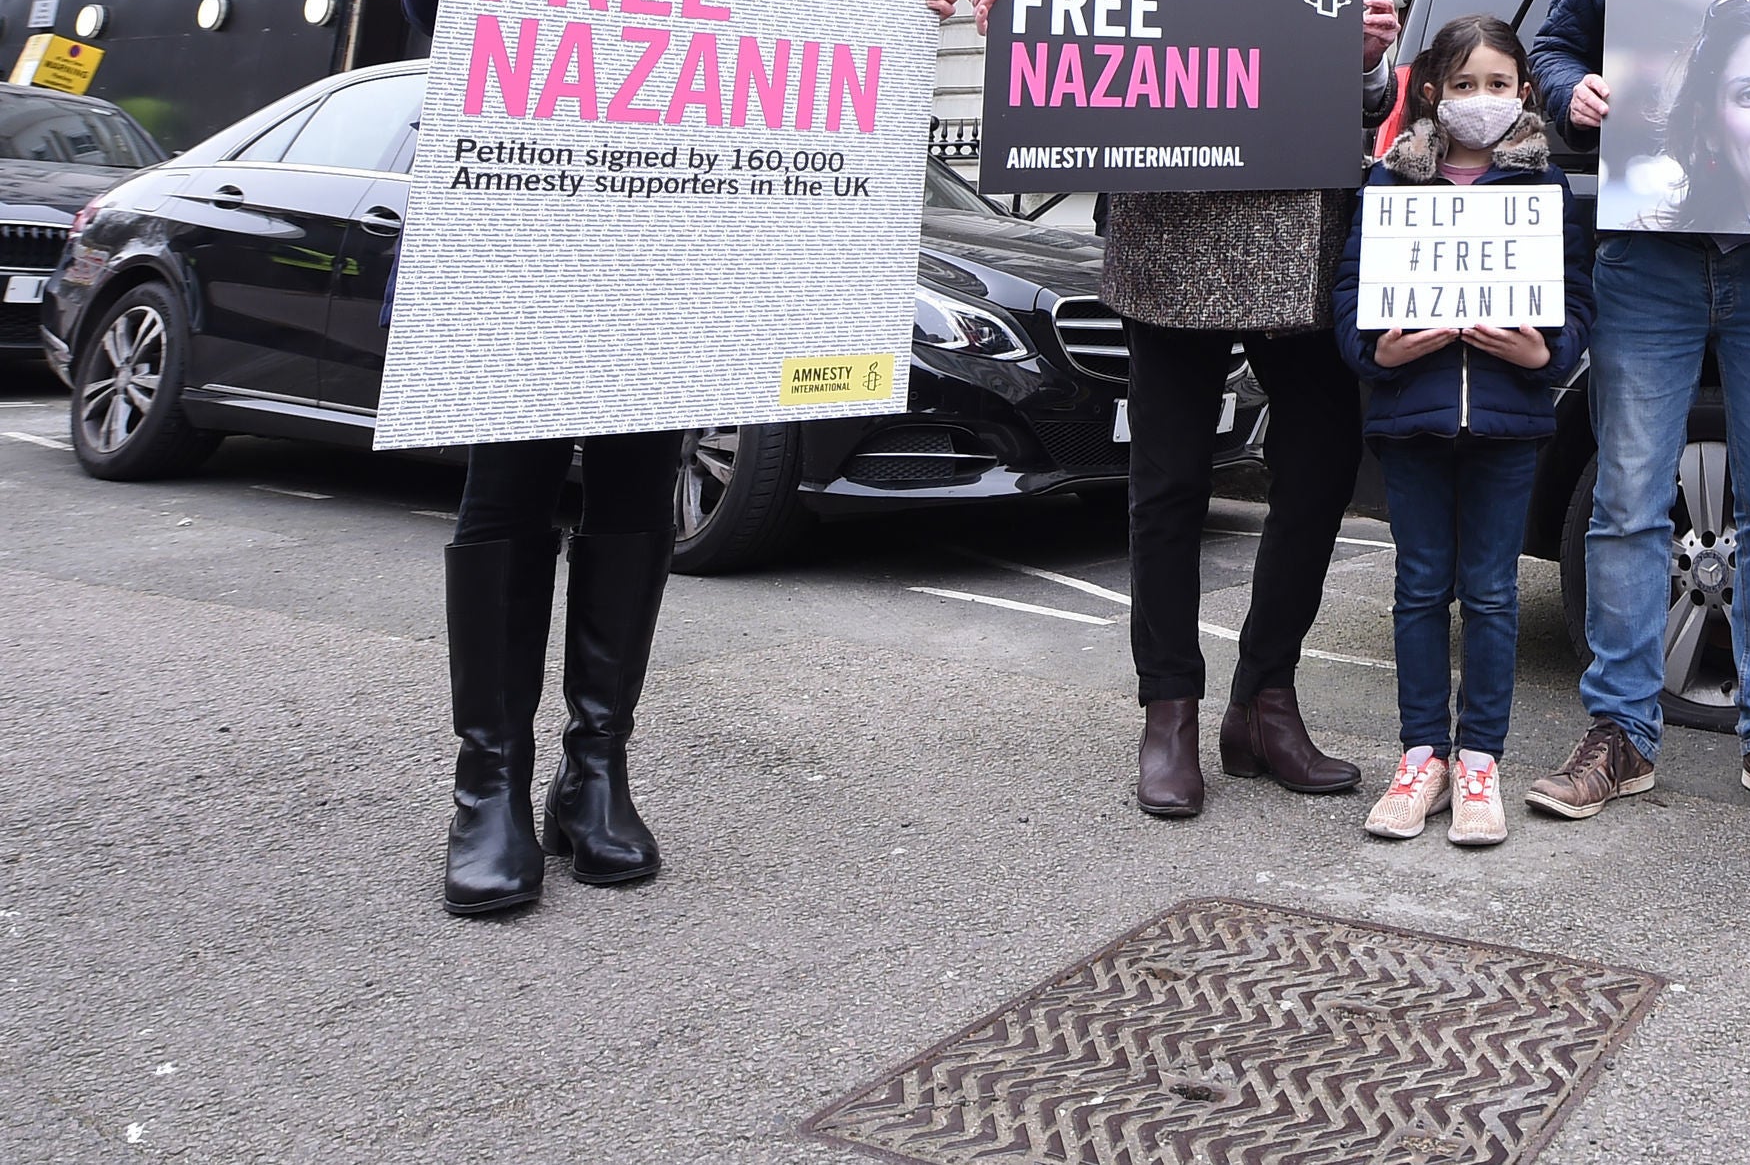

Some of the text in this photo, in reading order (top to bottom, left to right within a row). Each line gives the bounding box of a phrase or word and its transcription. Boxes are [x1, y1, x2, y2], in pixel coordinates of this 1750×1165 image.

[463, 15, 882, 134] NAZANIN
[1010, 43, 1260, 107] NAZANIN
[454, 137, 845, 174] Petition signed by 160,000
[1007, 147, 1244, 168] AMNESTY INTERNATIONAL
[450, 167, 871, 200] Amnesty supporters in the UK
[1380, 197, 1539, 226] HELP US
[1410, 240, 1516, 271] #FREE
[1382, 286, 1541, 318] NAZANIN
[792, 381, 850, 393] INTERNATIONAL
[793, 367, 852, 384] AMNESTY
